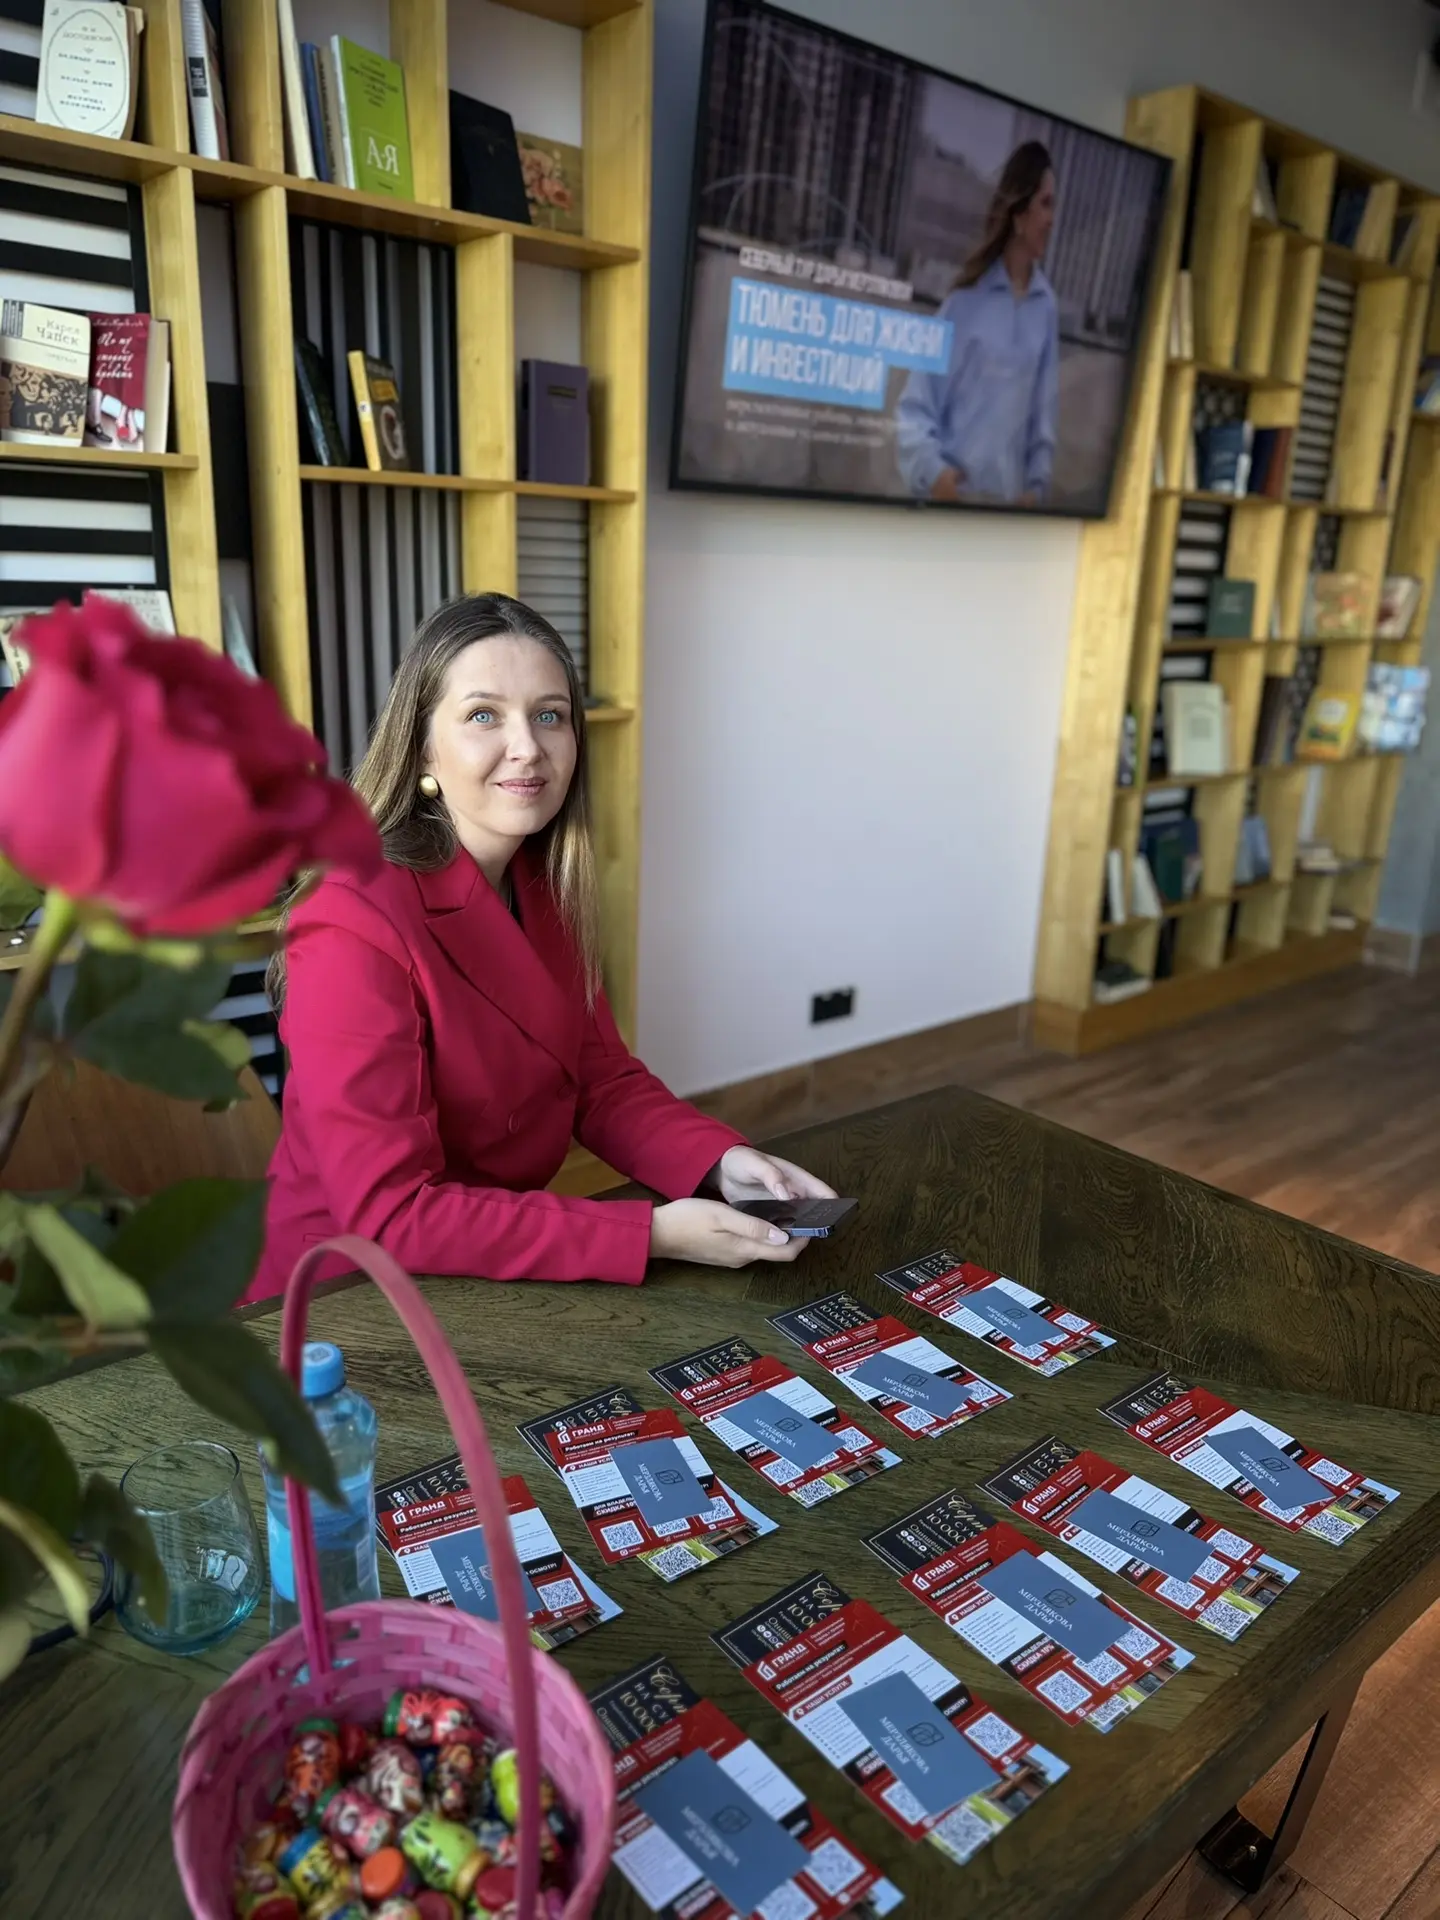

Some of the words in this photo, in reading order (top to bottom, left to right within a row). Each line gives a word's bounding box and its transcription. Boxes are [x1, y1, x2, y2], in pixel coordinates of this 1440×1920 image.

[738, 284, 827, 338] ТЮМЕНЬ
[829, 304, 876, 347] ДЛЯ
[876, 311, 946, 358] ЖИЗНИ
[731, 334, 748, 373] И
[751, 338, 884, 395] ИНВЕСТИЦИЙ
[823, 1335, 849, 1348] ГРАНД
[692, 1379, 721, 1393] ГРАНД
[572, 1424, 605, 1437] ГРАНД
[1144, 1414, 1169, 1430] ГРАНД
[754, 1418, 796, 1448] МЕРЗЛЯКОВА
[565, 1441, 594, 1452] Работаем
[1032, 1485, 1057, 1504] ГРАНД
[408, 1500, 446, 1517] ГРАНД
[594, 1503, 606, 1511] ДЛЯ
[606, 1497, 635, 1509] ВЛАДЕЛЬ
[596, 1504, 625, 1516] СКИДКА
[400, 1520, 433, 1533] Работаем
[1107, 1522, 1164, 1556] МЕРЗЛЯКОВА
[1116, 1536, 1147, 1553] ДАРЬЯ
[461, 1556, 487, 1600] МЕРЗЛЯКОВА
[529, 1563, 557, 1575] ОСМОТР!
[924, 1559, 956, 1580] ГРАНД
[454, 1570, 468, 1592] ДАРЬЯ
[428, 1592, 442, 1601] ДЛЯ
[930, 1582, 957, 1599] Работаем
[430, 1595, 453, 1605] СКИД
[959, 1602, 977, 1617] НАШИ
[1018, 1588, 1073, 1631] МЕРЗЛЯКОВА
[1024, 1604, 1055, 1625] ДАРЬЯ
[771, 1643, 808, 1668] ГРАНД
[1016, 1651, 1041, 1672] СКИДКА
[1039, 1644, 1055, 1659] 10%
[776, 1671, 806, 1691] Работаем
[634, 1682, 650, 1700] НА
[805, 1695, 826, 1710] НАШИ
[943, 1696, 968, 1717] ОСМОТР!
[879, 1716, 930, 1775] МЕРЗЛЯКОВА
[880, 1735, 910, 1765] ДАРЬЯ
